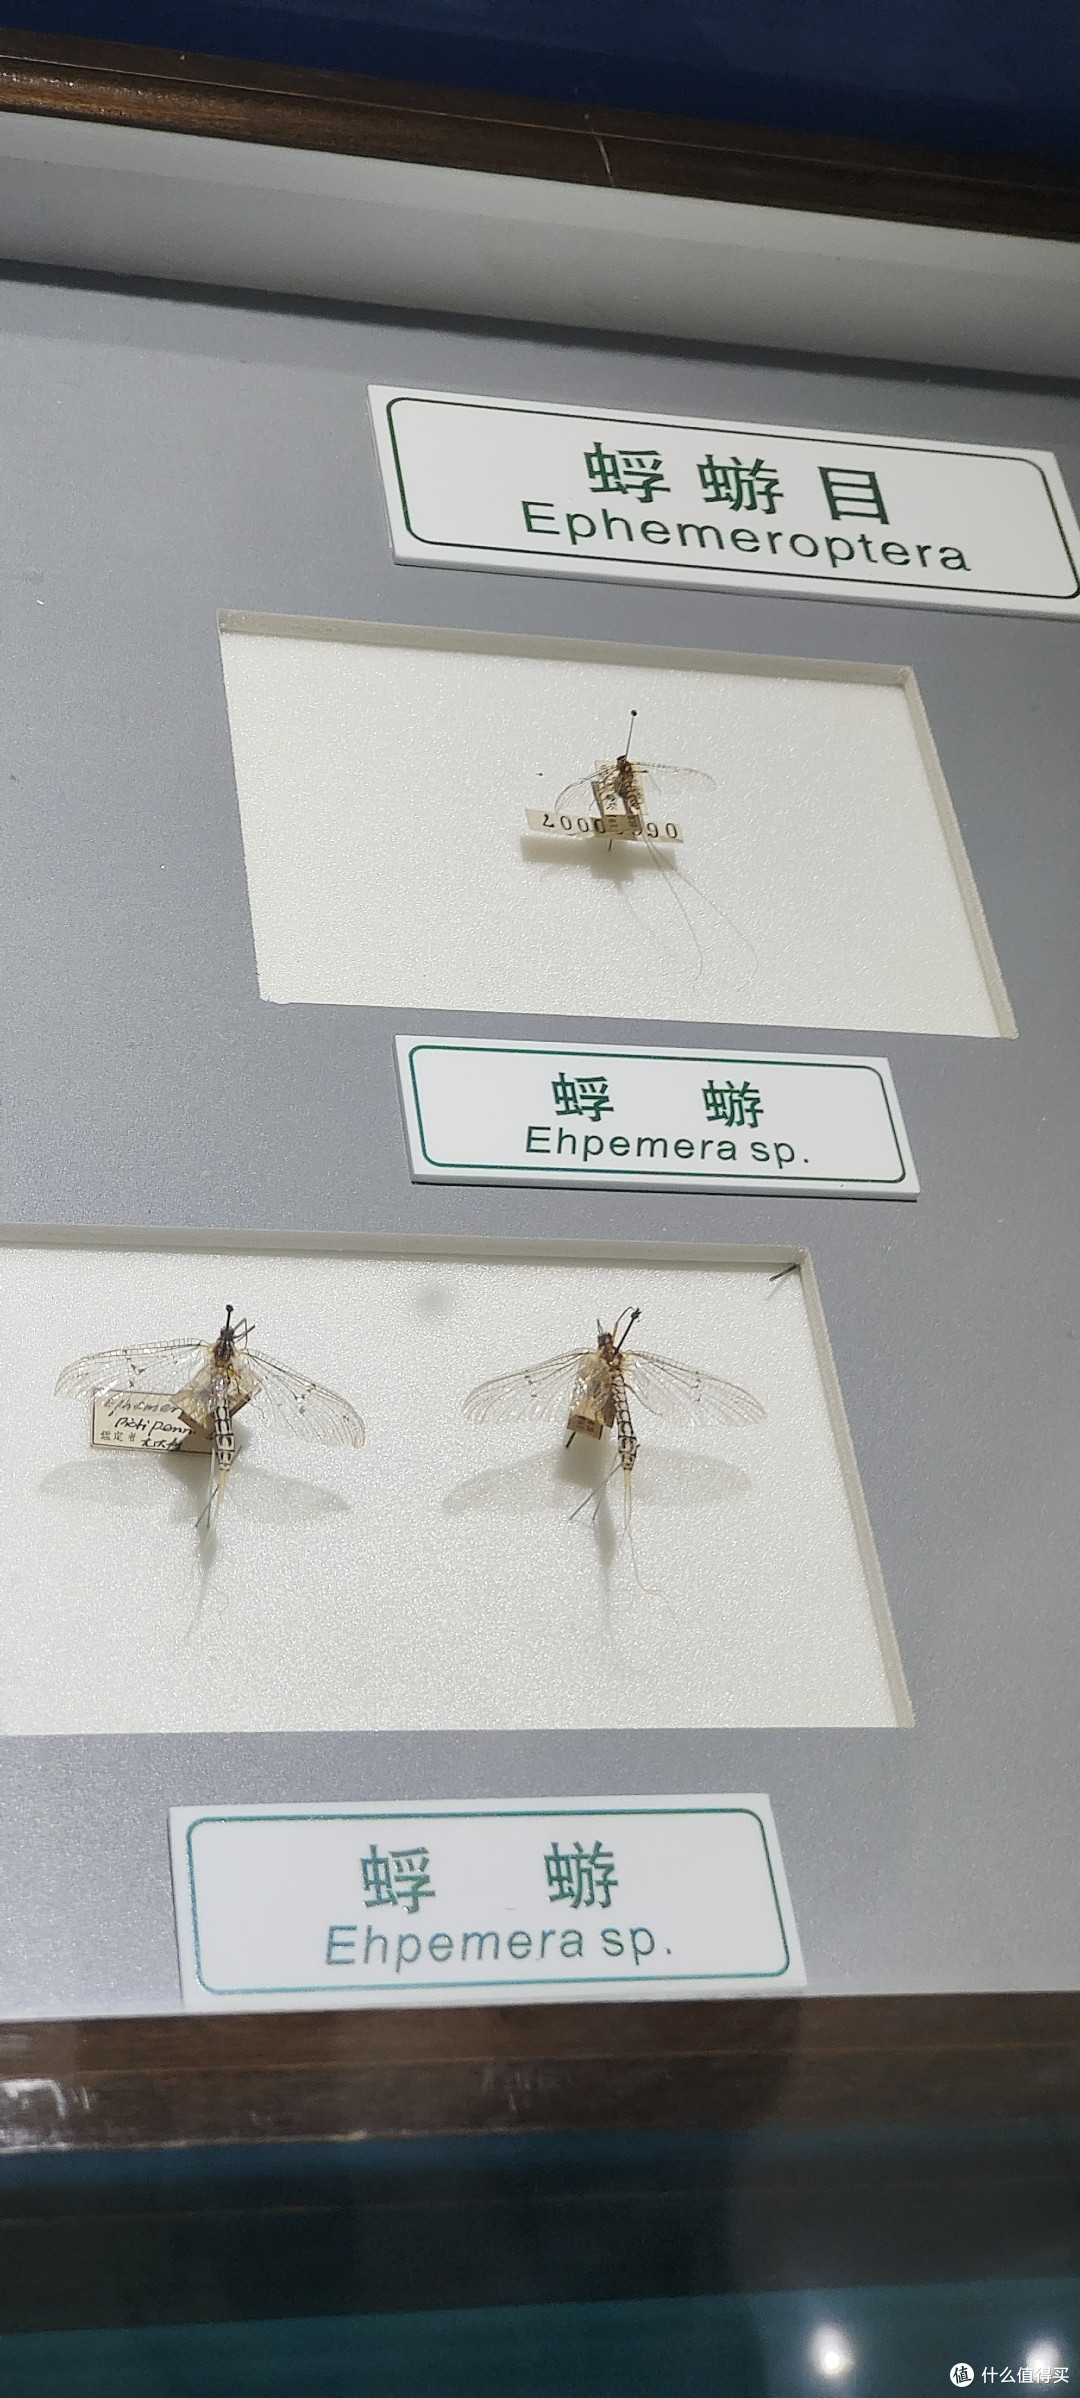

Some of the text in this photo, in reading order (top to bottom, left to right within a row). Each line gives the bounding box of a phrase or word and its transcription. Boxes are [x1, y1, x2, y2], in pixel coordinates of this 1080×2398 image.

[584, 441, 891, 526] 蜉蝣目
[521, 500, 972, 572] Ephemeroptera
[542, 813, 678, 839] 200090
[551, 1071, 765, 1130] 蜉蝣
[525, 1125, 810, 1170] Ehpemera sp.
[360, 1841, 619, 1914] 蜉蝣
[325, 1924, 672, 1973] Ehpemera sp.
